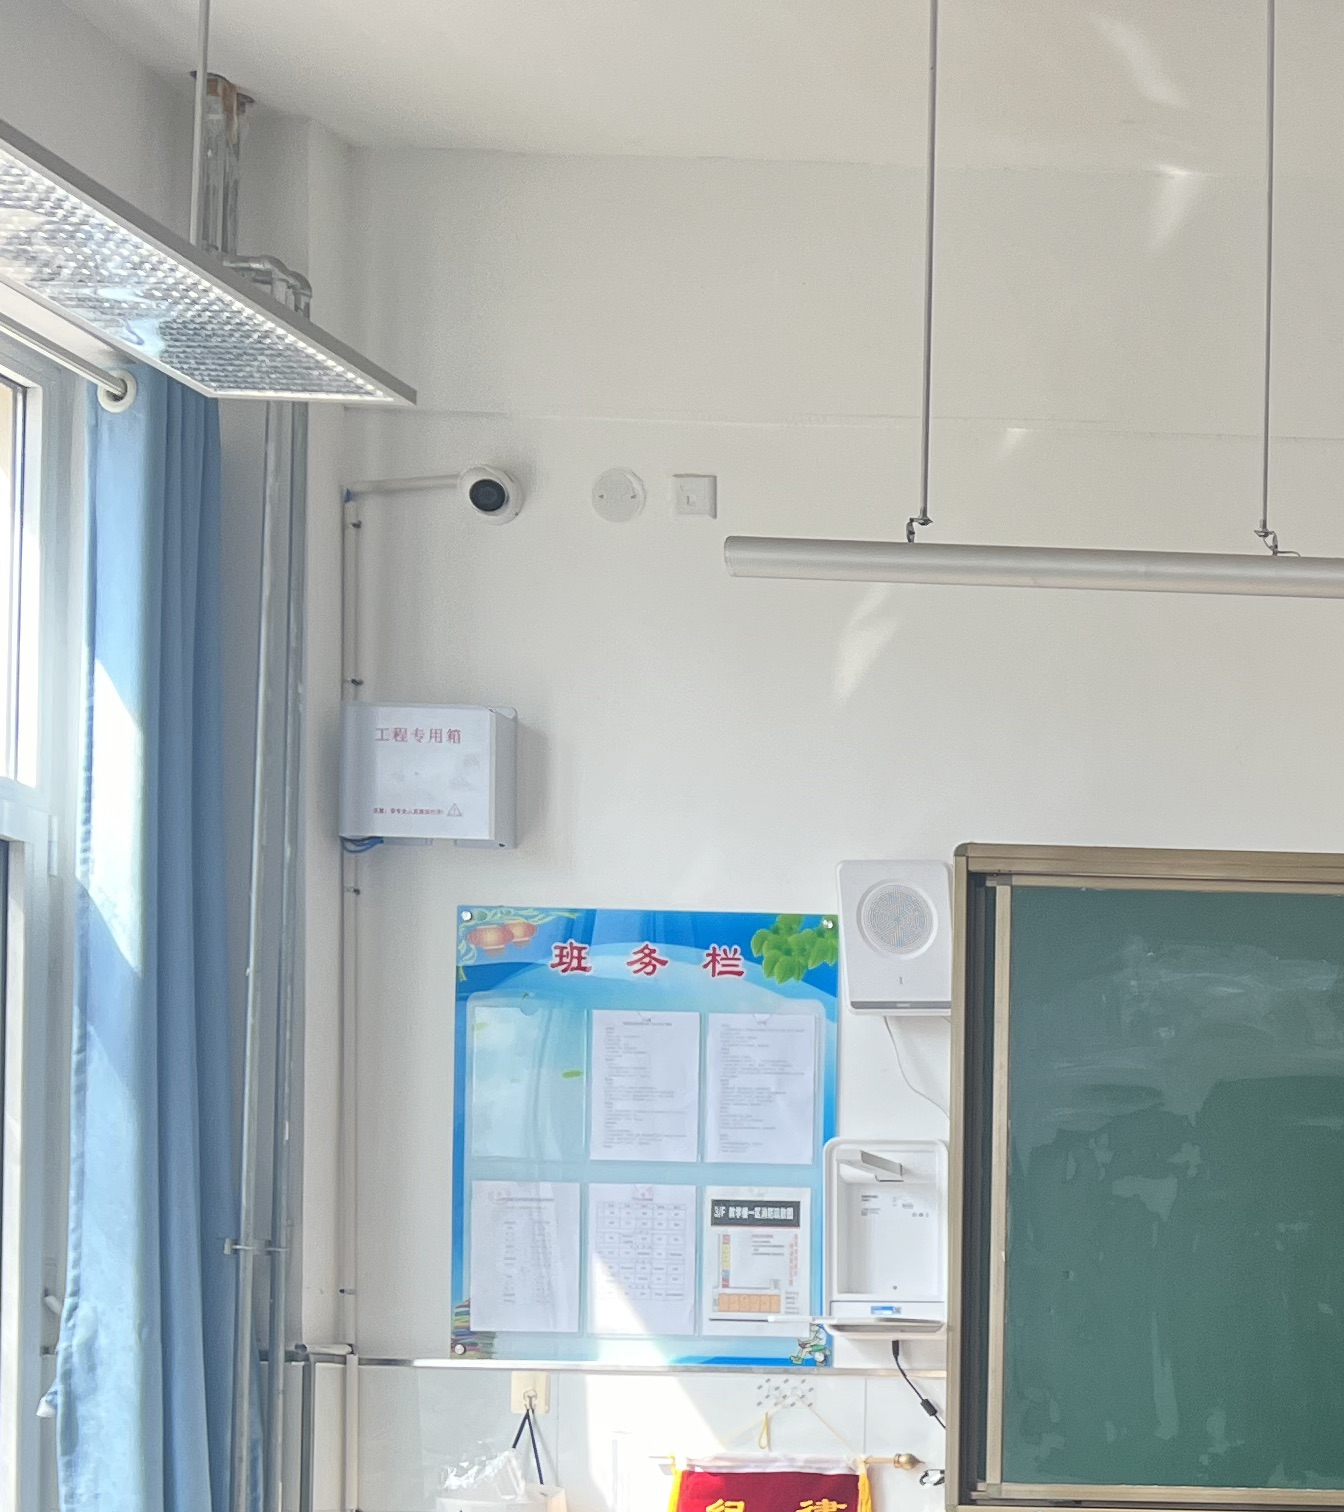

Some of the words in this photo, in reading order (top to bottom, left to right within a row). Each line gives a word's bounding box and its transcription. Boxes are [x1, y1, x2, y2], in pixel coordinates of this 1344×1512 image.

[375, 727, 461, 744] 工程专用箱
[550, 941, 745, 977] 班务栏
